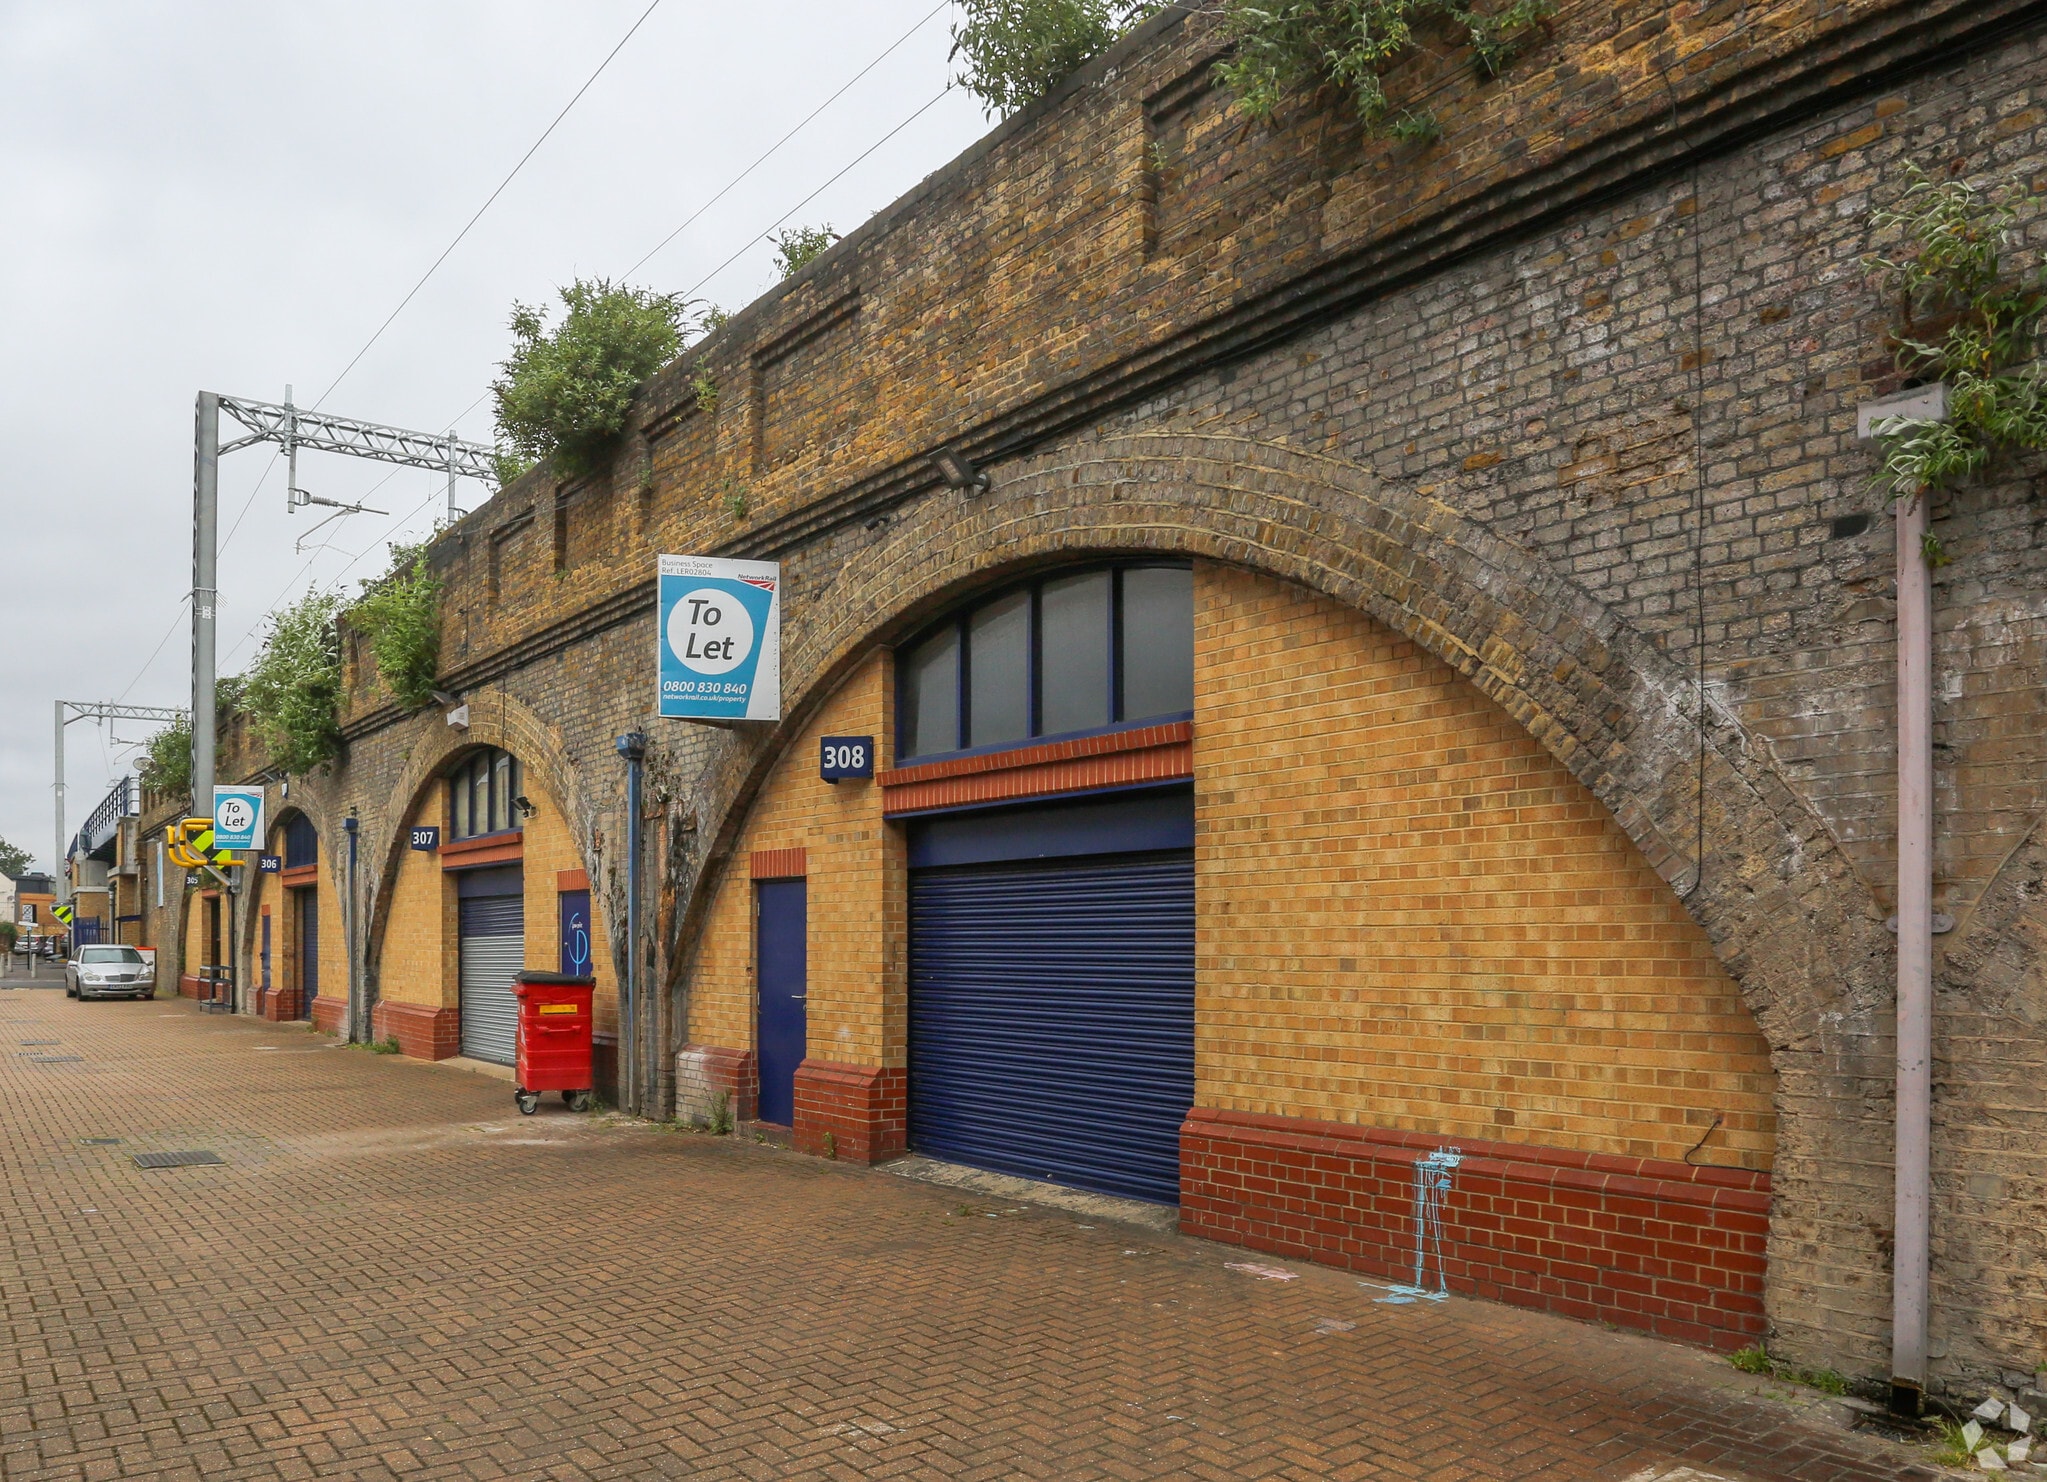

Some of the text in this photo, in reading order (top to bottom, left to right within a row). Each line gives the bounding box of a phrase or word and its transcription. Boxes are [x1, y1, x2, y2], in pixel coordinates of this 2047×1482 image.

[661, 559, 713, 569] Business Space
[688, 599, 722, 626] To
[685, 633, 735, 660] Let
[663, 680, 747, 694] 0800 830 840
[663, 694, 746, 703] networkrail.co.uk/property
[824, 745, 865, 769] 308
[226, 802, 240, 813] To
[225, 816, 245, 826] Let
[412, 831, 433, 844] 307
[261, 859, 277, 869] 306
[186, 876, 198, 884] 305
